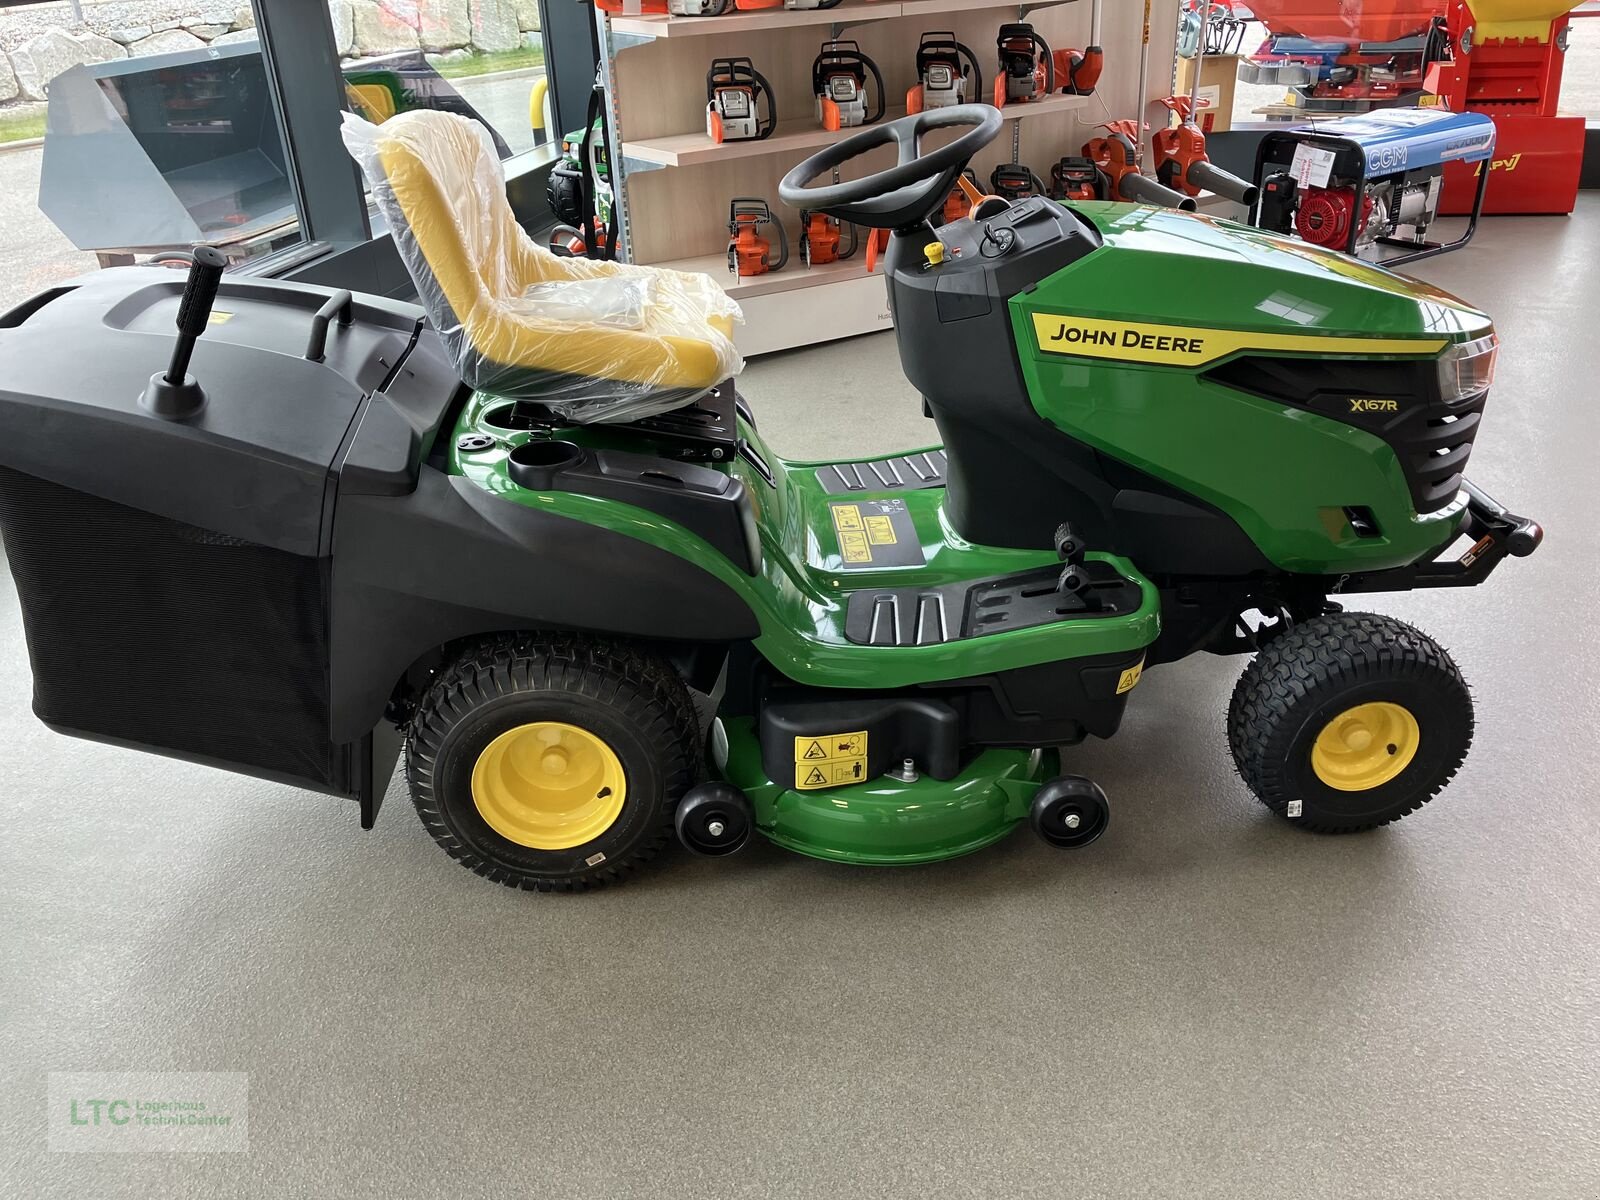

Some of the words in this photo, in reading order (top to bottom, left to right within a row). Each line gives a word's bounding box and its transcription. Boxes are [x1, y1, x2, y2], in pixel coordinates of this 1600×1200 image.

[1368, 146, 1408, 171] CGM
[1050, 323, 1117, 346] JOHN
[1121, 330, 1205, 354] DEERE
[1349, 398, 1398, 412] X167R
